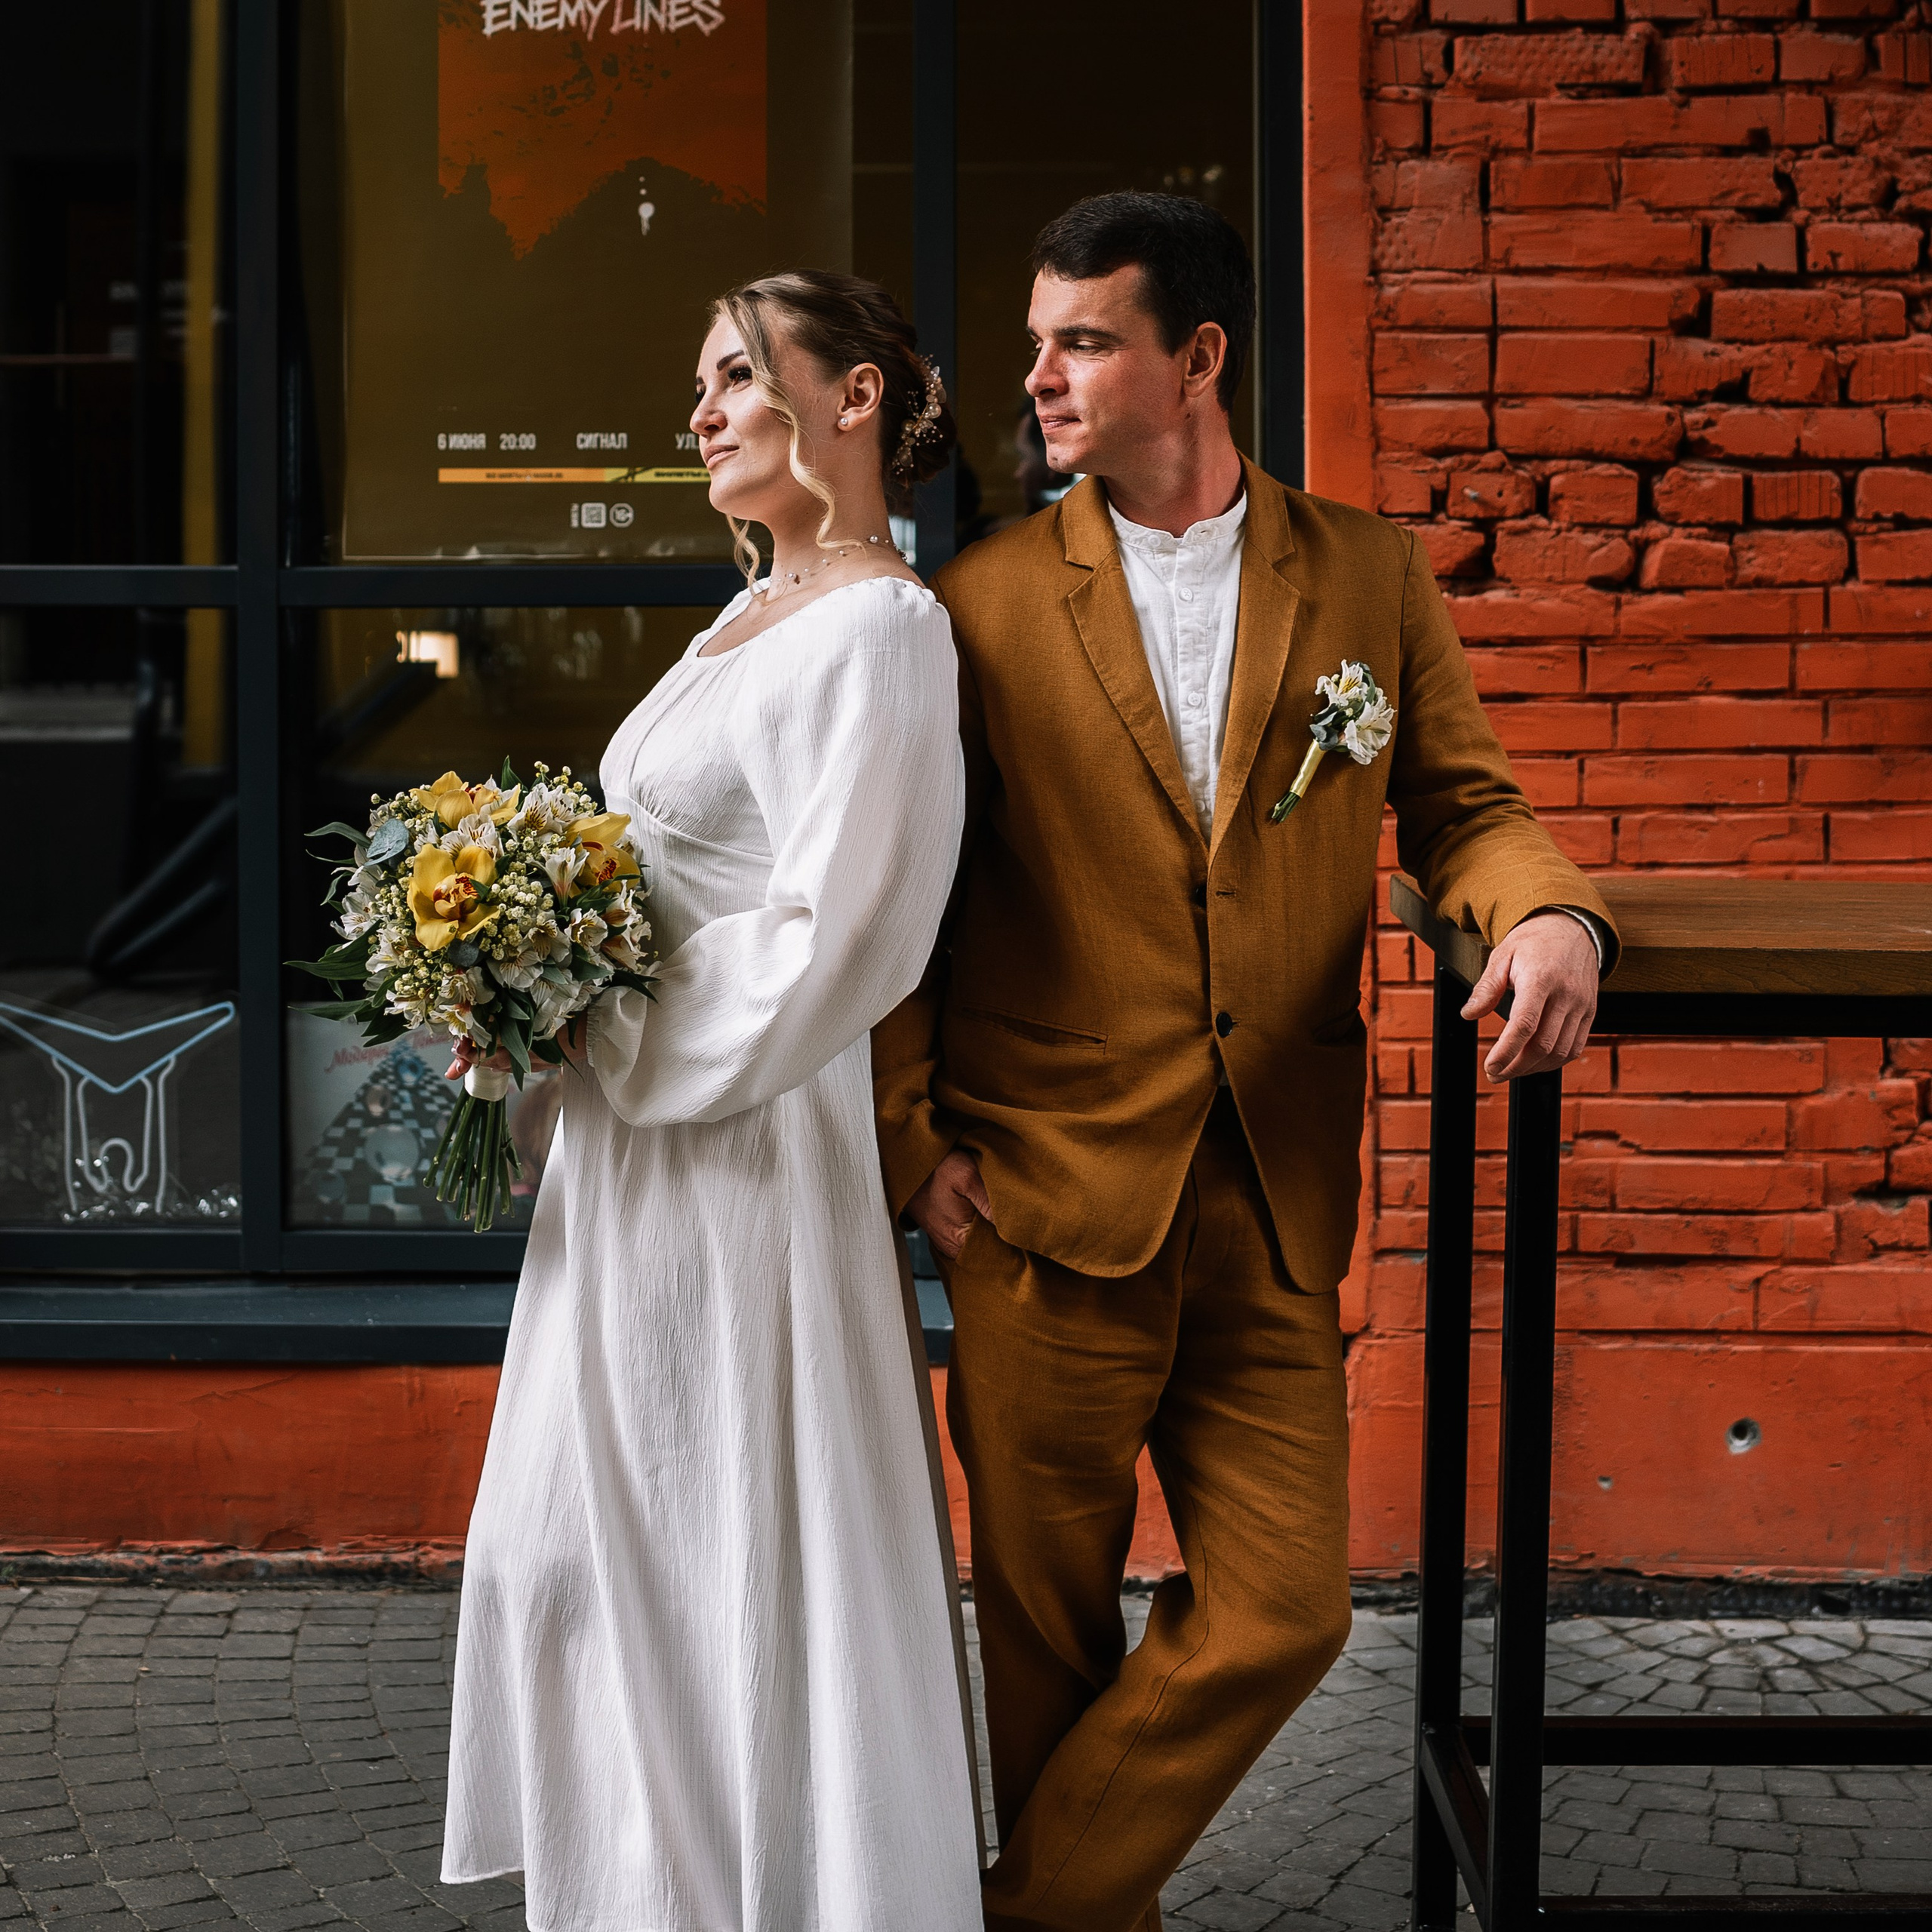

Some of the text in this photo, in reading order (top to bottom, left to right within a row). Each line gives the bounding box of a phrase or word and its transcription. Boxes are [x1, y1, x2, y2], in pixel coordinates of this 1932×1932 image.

[481, 0, 725, 40] ENEMY LINES
[438, 432, 487, 451] 6 ИЮНЯ
[499, 432, 537, 450] 20:00
[576, 432, 628, 450] СИГНАЛ
